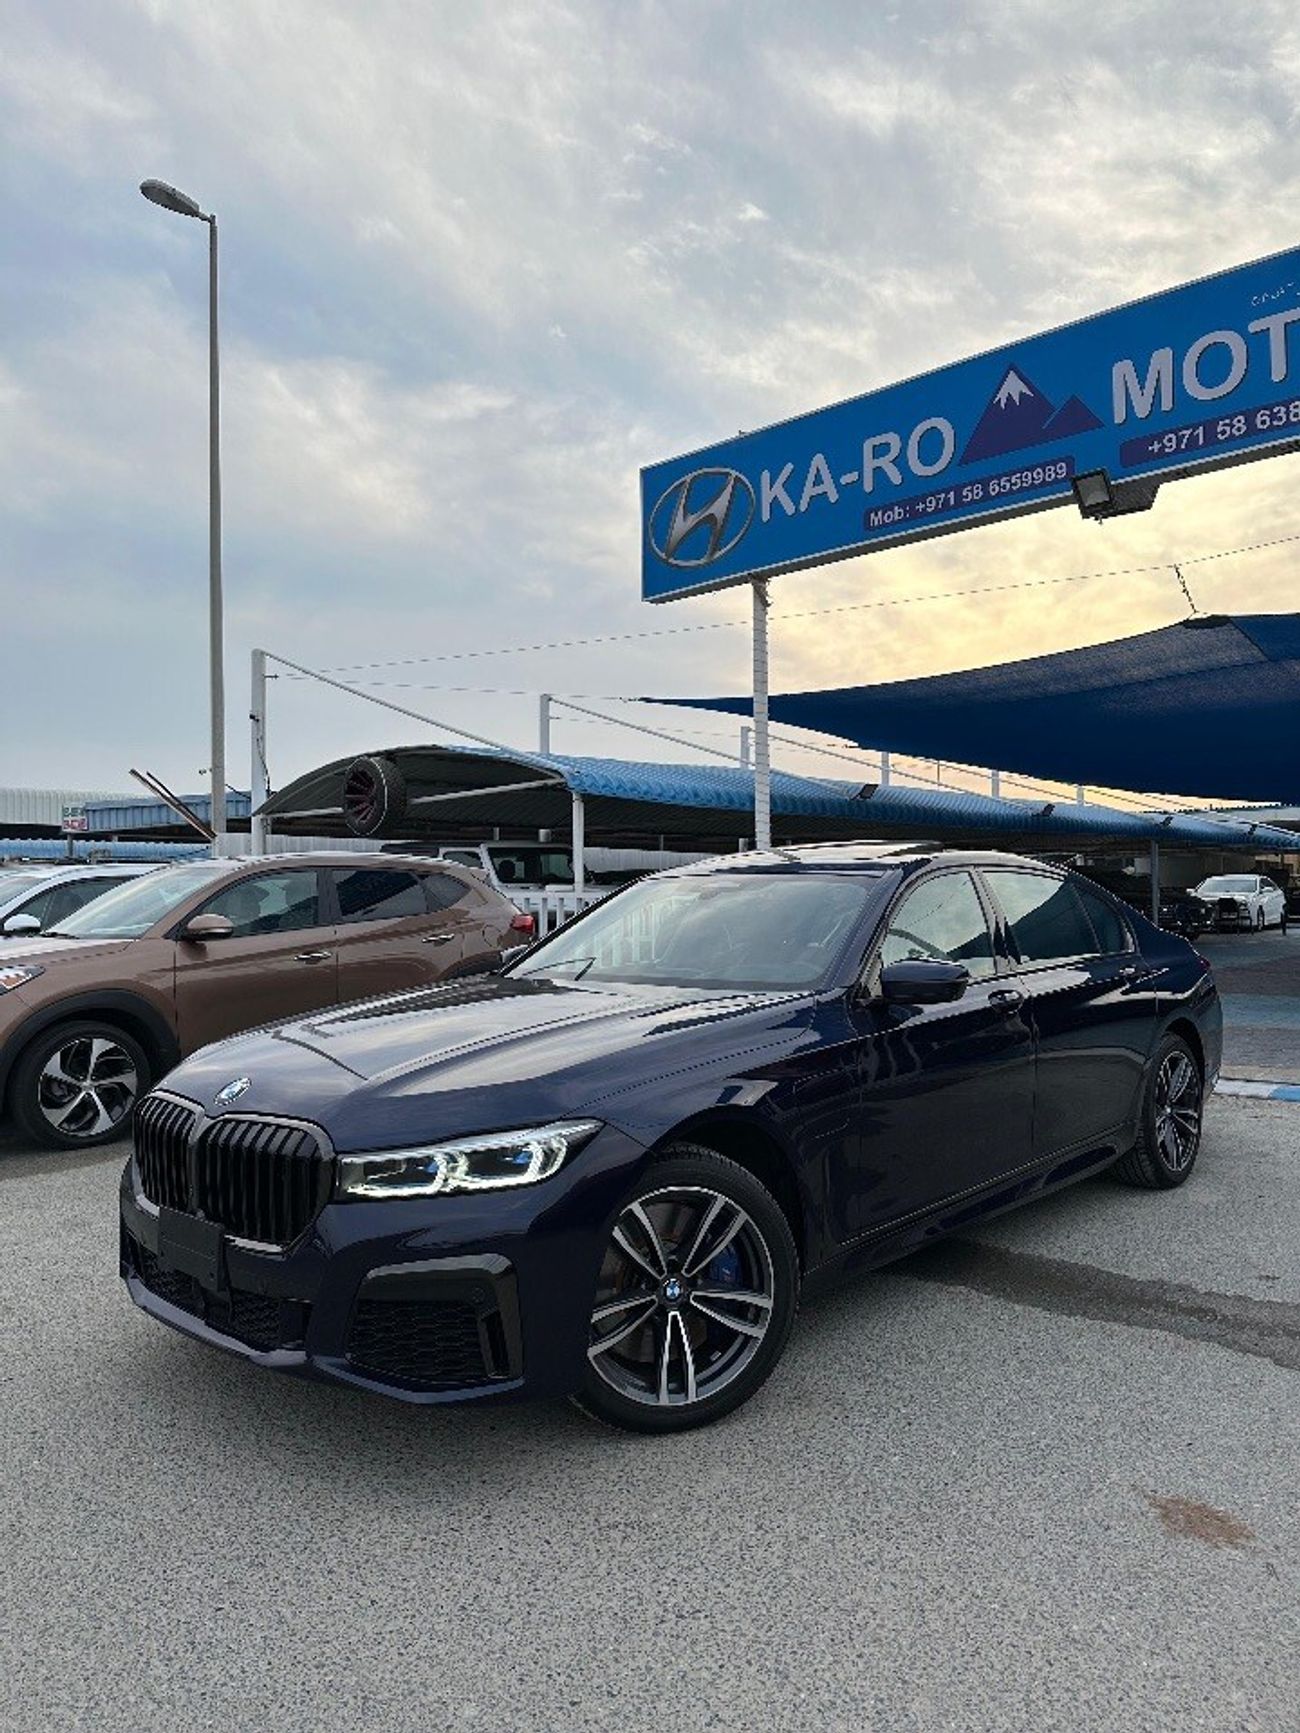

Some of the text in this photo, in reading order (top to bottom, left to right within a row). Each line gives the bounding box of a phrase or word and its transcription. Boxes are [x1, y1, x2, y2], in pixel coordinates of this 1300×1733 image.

[760, 307, 1300, 523] KA-RO MOT
[1148, 400, 1300, 453] +971 58 638
[869, 462, 1067, 527] Mob: +971 58 6559989
